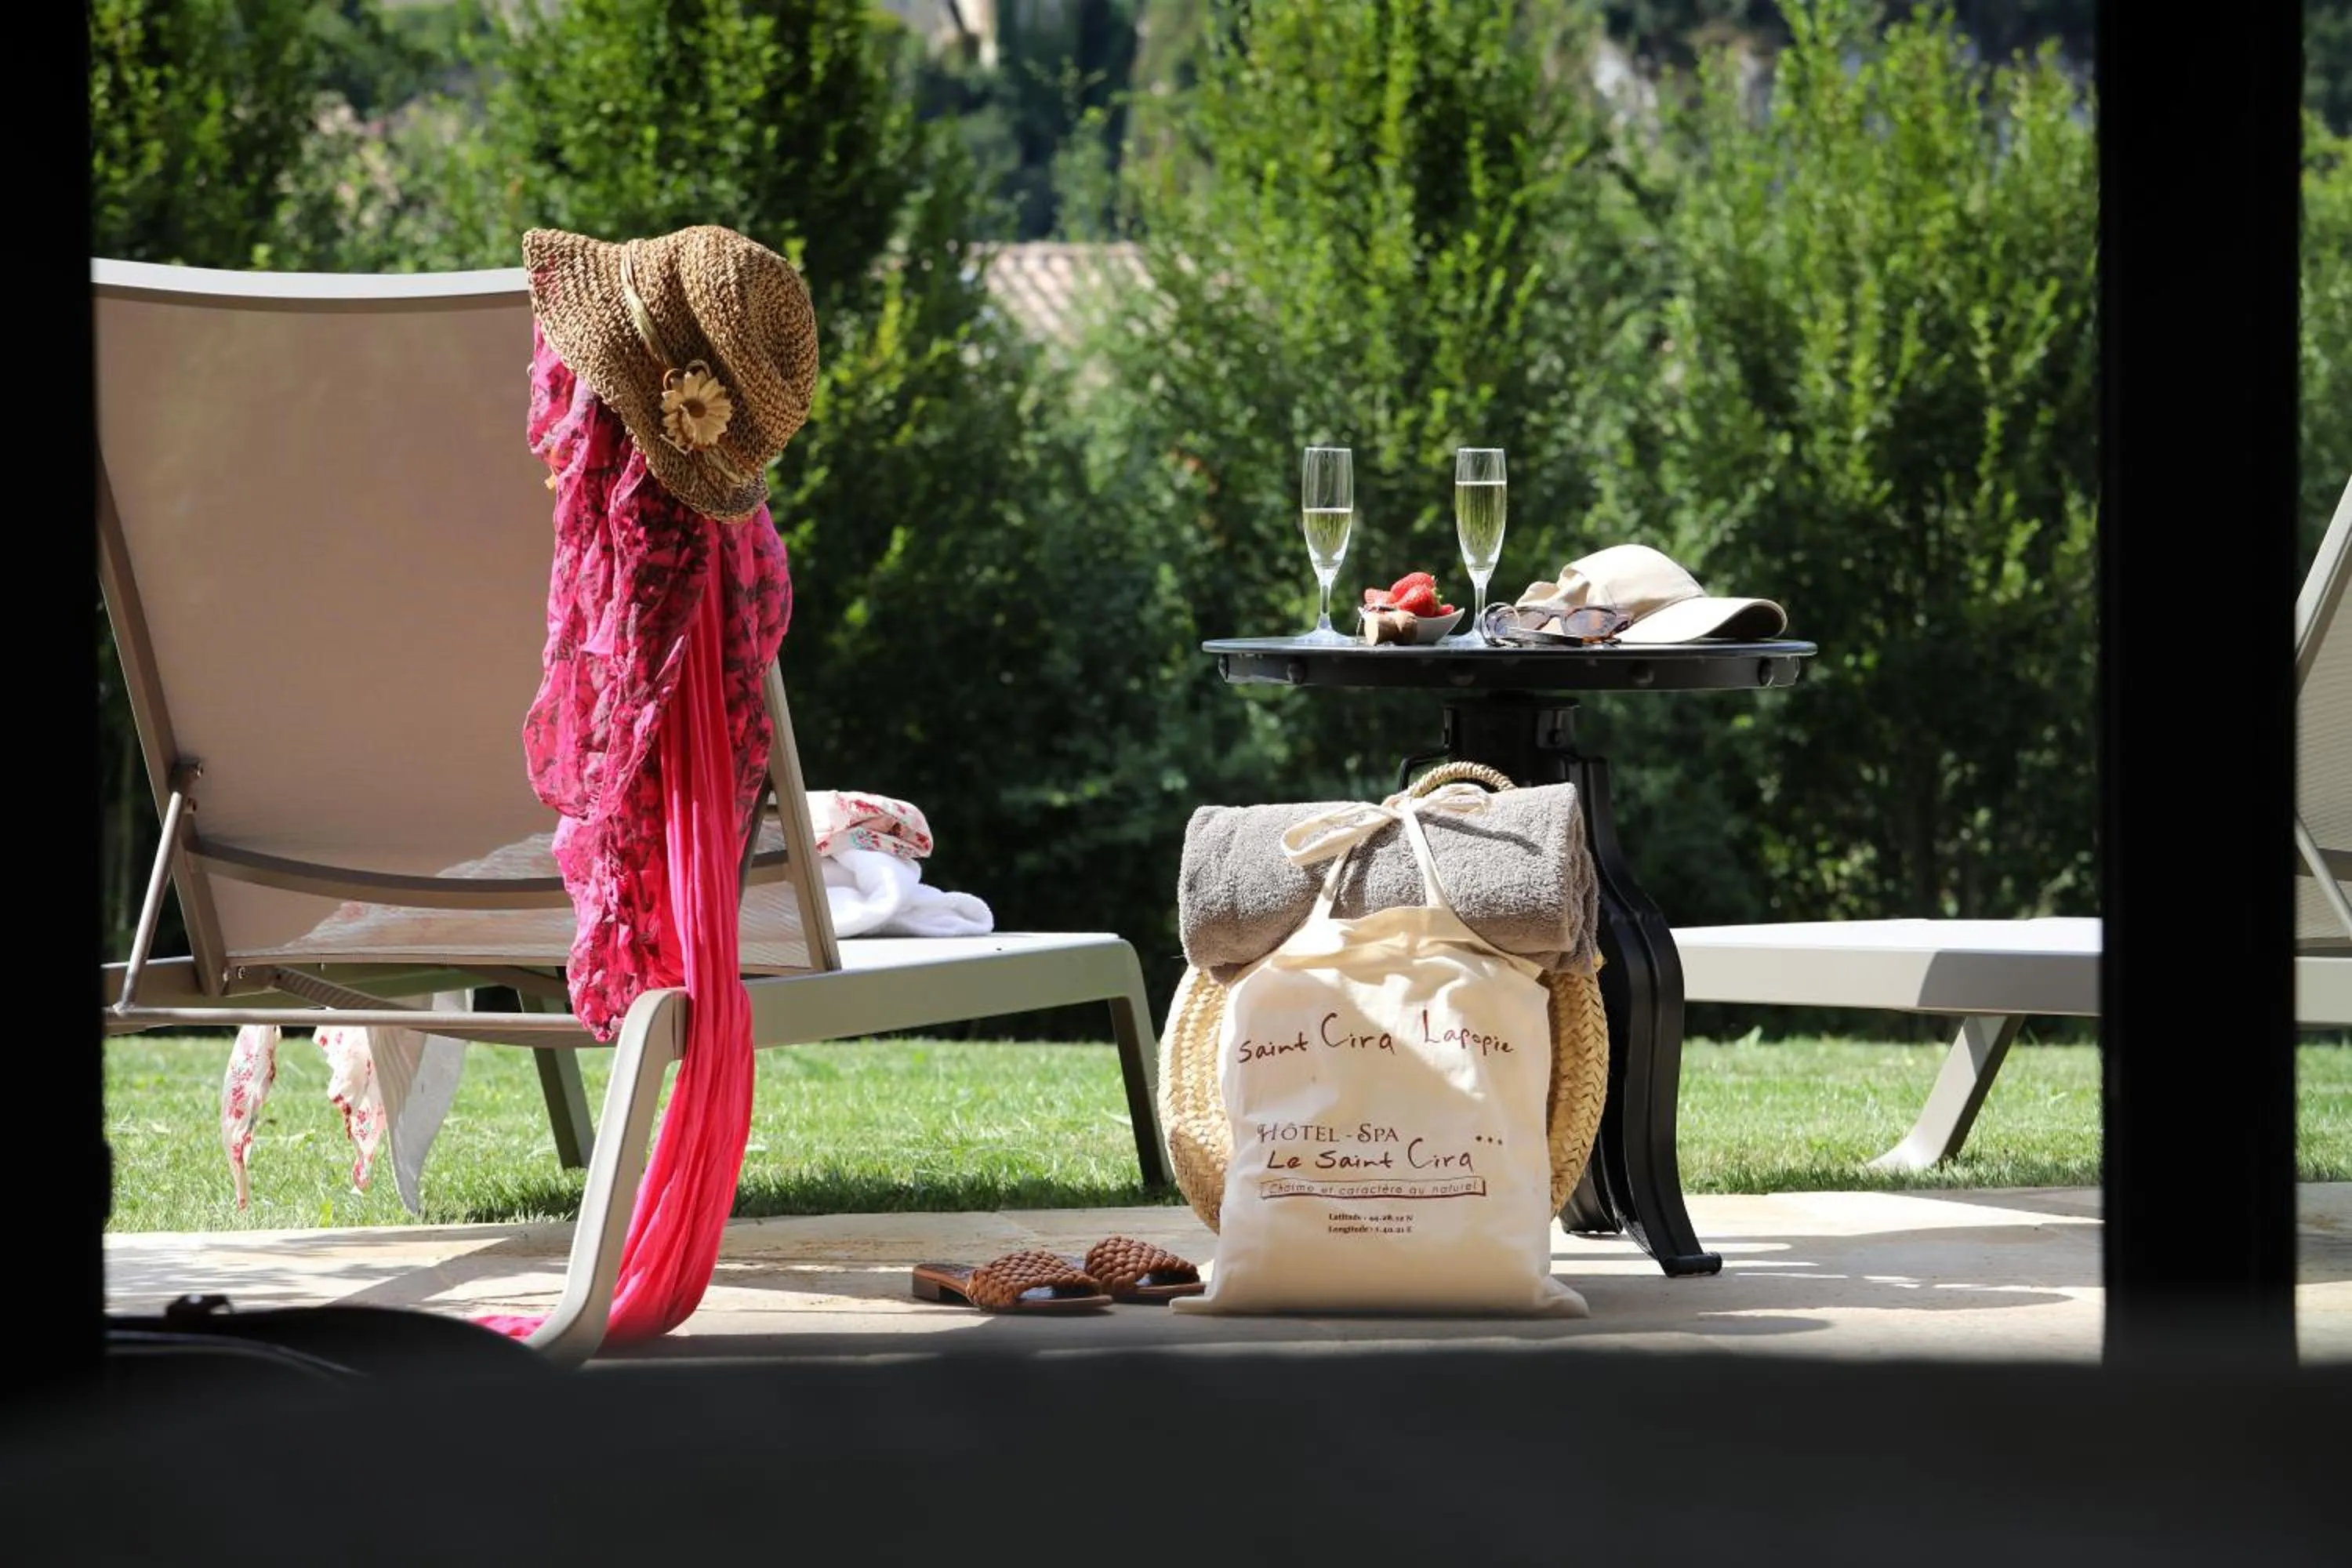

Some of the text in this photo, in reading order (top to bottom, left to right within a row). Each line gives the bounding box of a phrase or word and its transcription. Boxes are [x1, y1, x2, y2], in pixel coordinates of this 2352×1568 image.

[1422, 1009, 1515, 1054] Lapopie
[1267, 1150, 1302, 1169] Le
[1315, 1150, 1393, 1169] Saint
[1320, 1185, 1334, 1194] et
[1409, 1186, 1425, 1195] au
[1432, 1180, 1477, 1194] naturel
